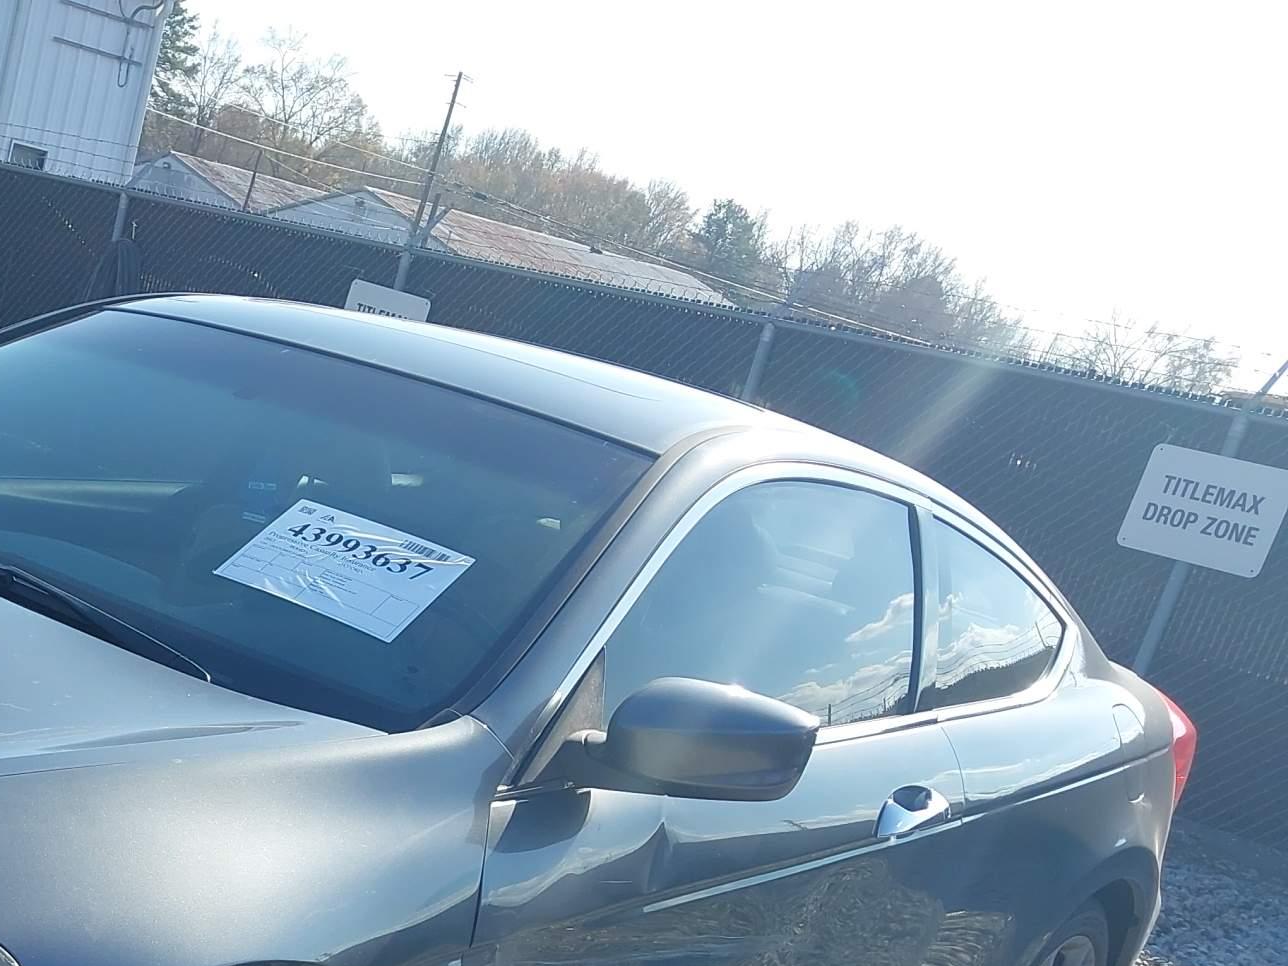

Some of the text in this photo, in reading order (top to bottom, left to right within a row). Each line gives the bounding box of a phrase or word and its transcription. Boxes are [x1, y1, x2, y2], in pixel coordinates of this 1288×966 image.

[1163, 474, 1266, 516] TITLEMAX
[1142, 502, 1260, 547] DROP ZONE
[287, 523, 434, 580] 43993637
